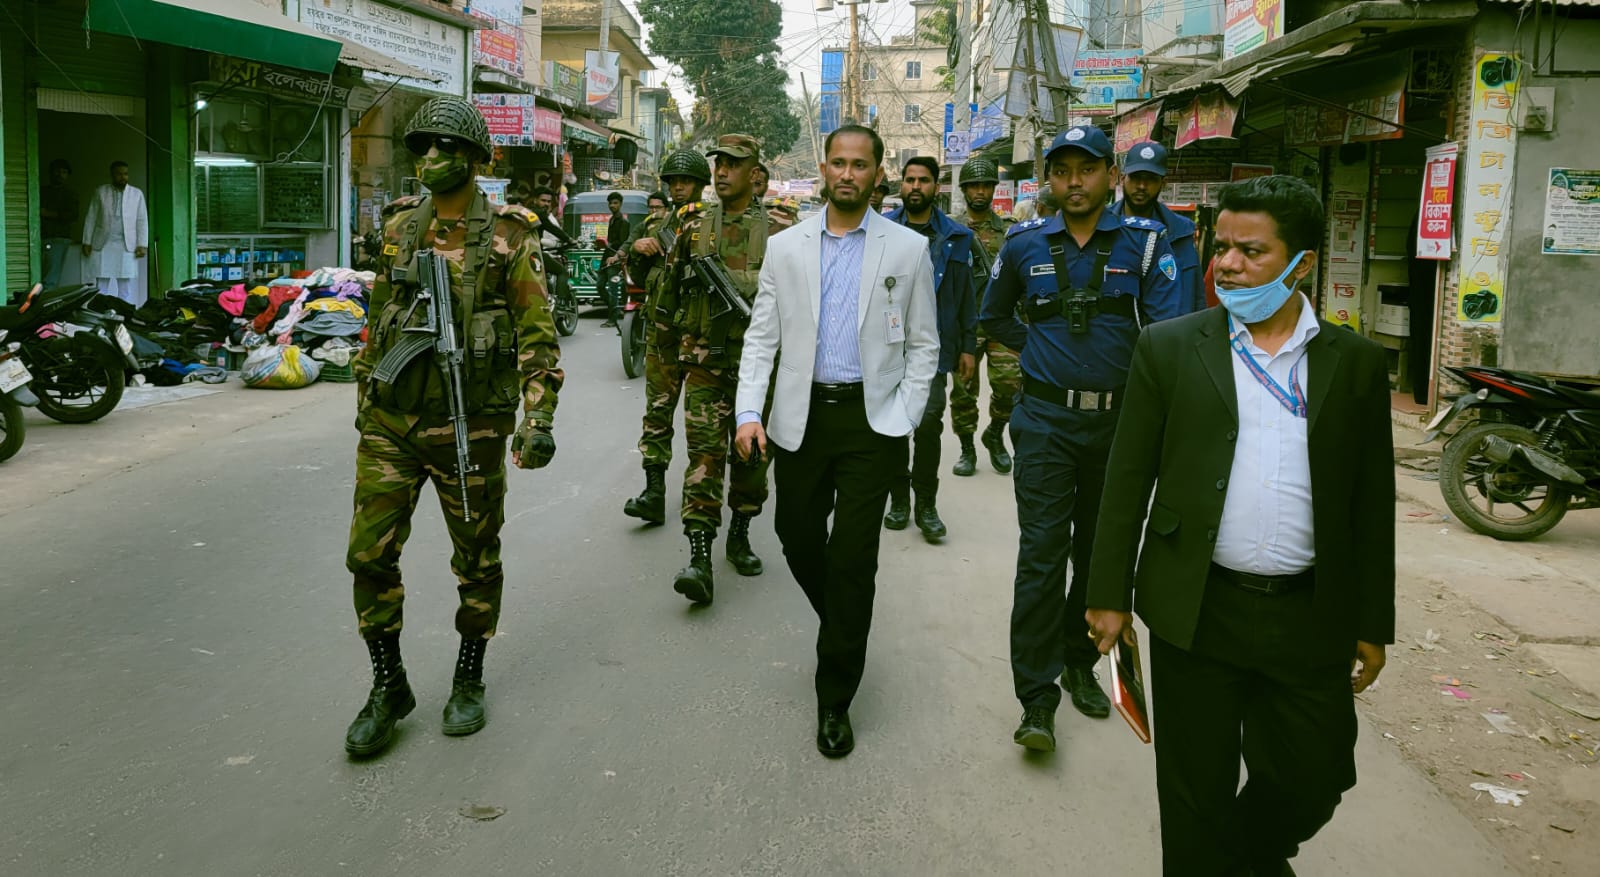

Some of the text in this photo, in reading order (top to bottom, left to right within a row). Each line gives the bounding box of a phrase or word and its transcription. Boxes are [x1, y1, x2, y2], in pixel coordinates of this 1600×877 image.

[1432, 186, 1448, 204] বিল
[1425, 200, 1452, 219] বিকাশ
[1426, 219, 1448, 233] করুন
